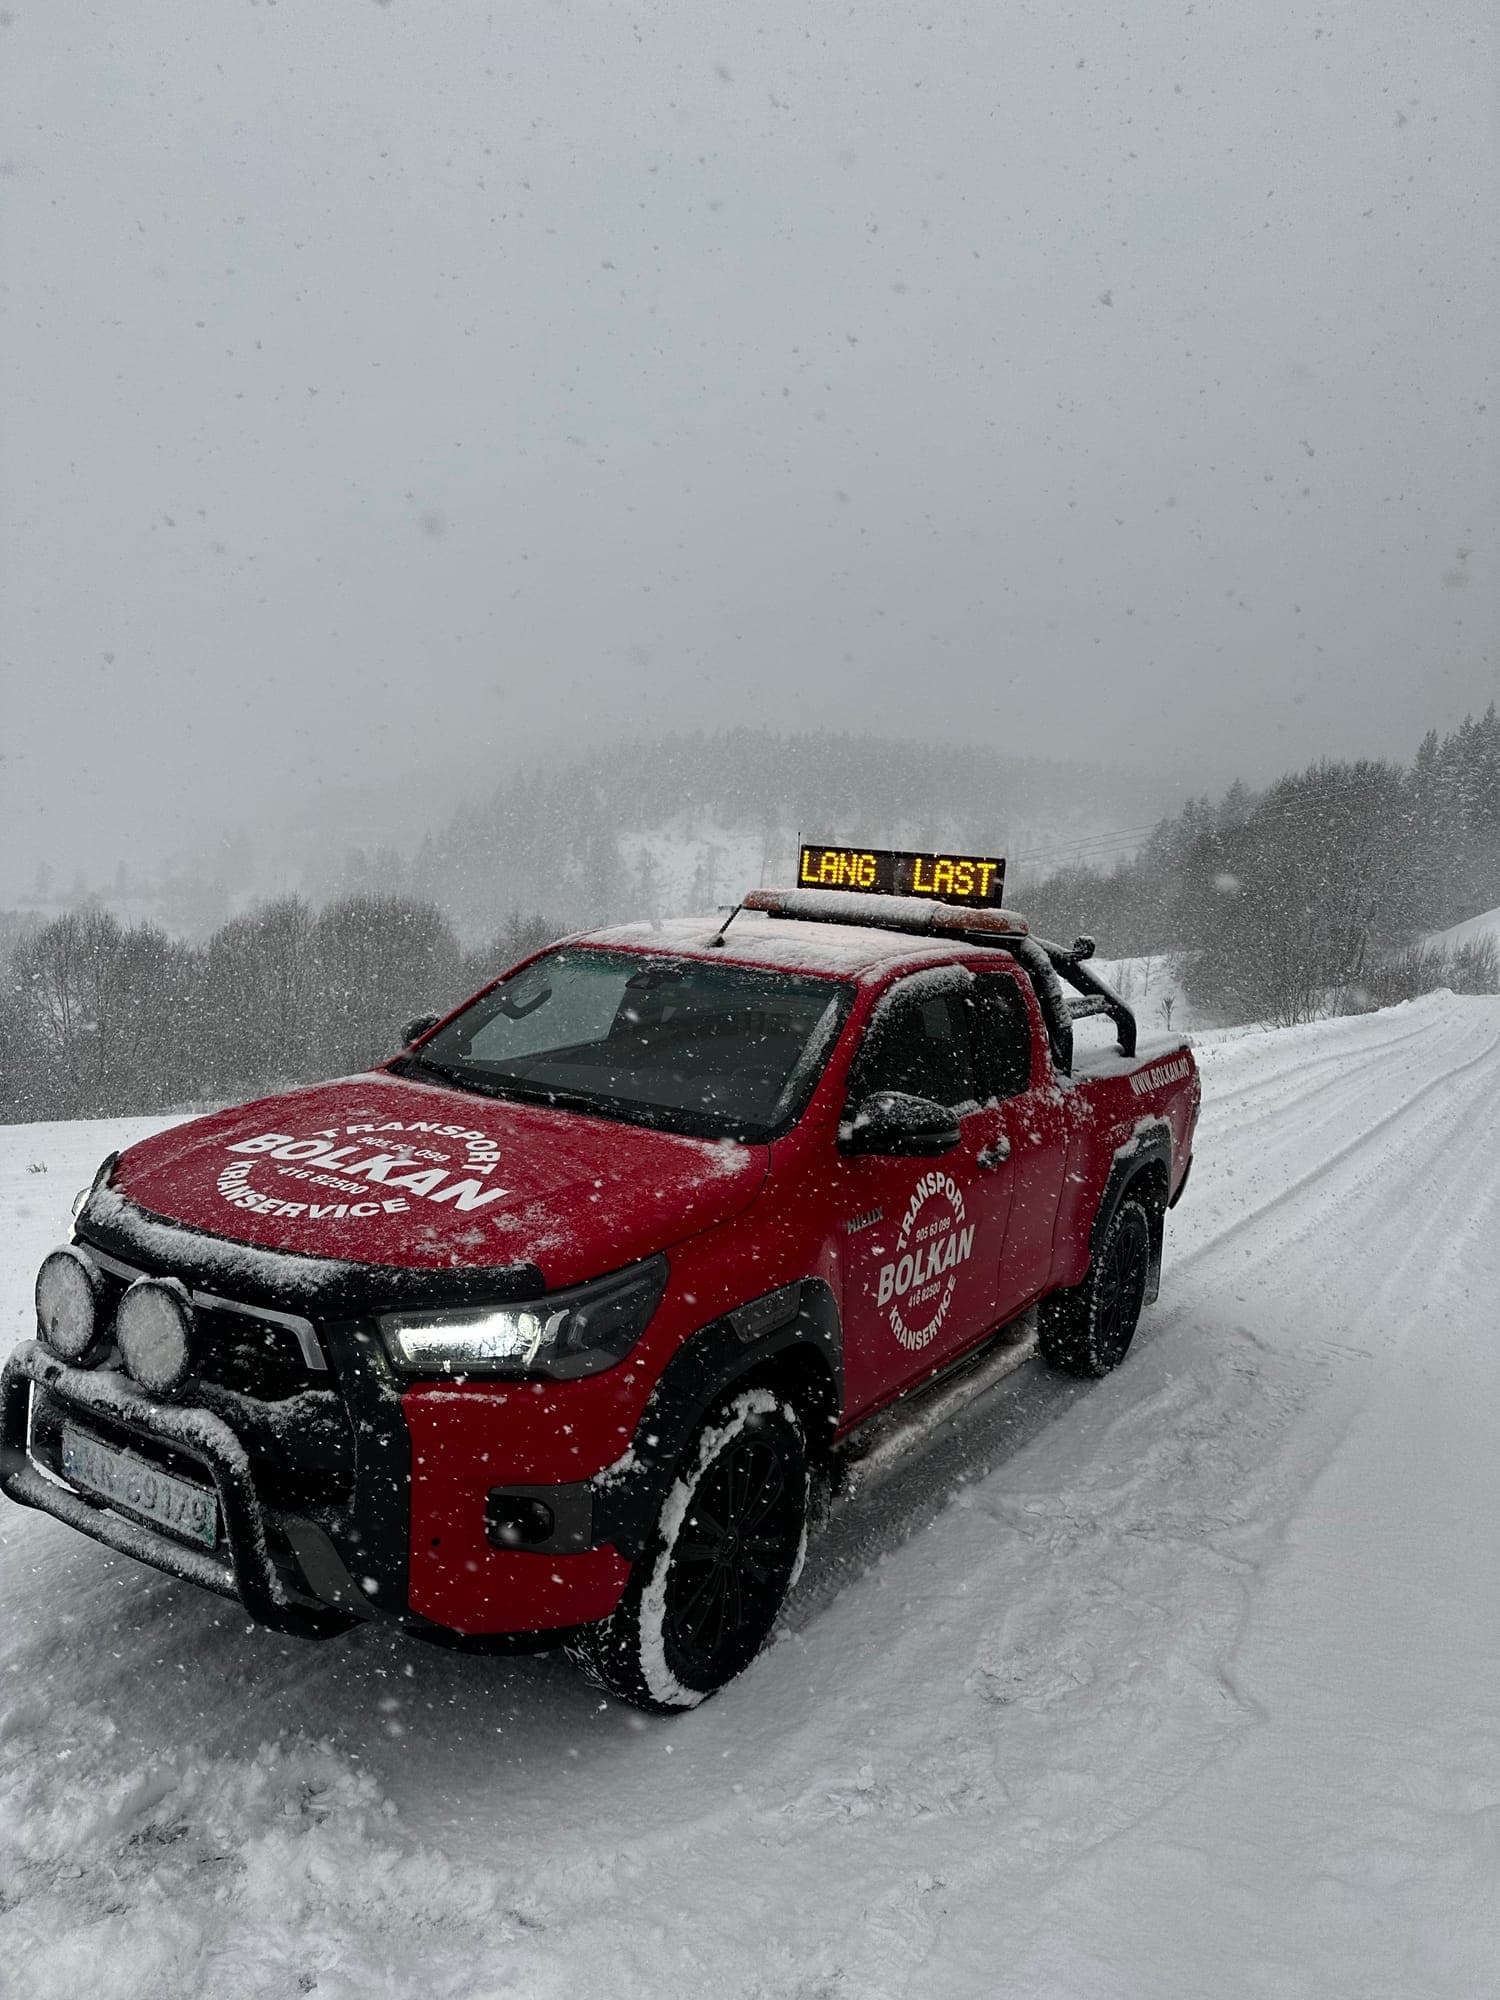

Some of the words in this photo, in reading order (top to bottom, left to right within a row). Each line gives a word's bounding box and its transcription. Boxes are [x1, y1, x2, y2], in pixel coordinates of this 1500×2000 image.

[801, 850, 877, 886] LANG
[913, 858, 997, 897] LAST
[225, 1132, 511, 1212] BOLKAN
[312, 1121, 501, 1175] TRANSPORT
[356, 1136, 394, 1147] 905
[414, 1149, 451, 1162] 099
[216, 1160, 412, 1219] KRANSERVICE
[277, 1167, 315, 1179] 416
[309, 1174, 370, 1194] 82500
[896, 1171, 966, 1252] TRANSPORT
[916, 1226, 929, 1243] 905
[929, 1222, 938, 1237] 63
[877, 1224, 975, 1307] BOLKAN
[889, 1274, 957, 1351] KRANSERVICE
